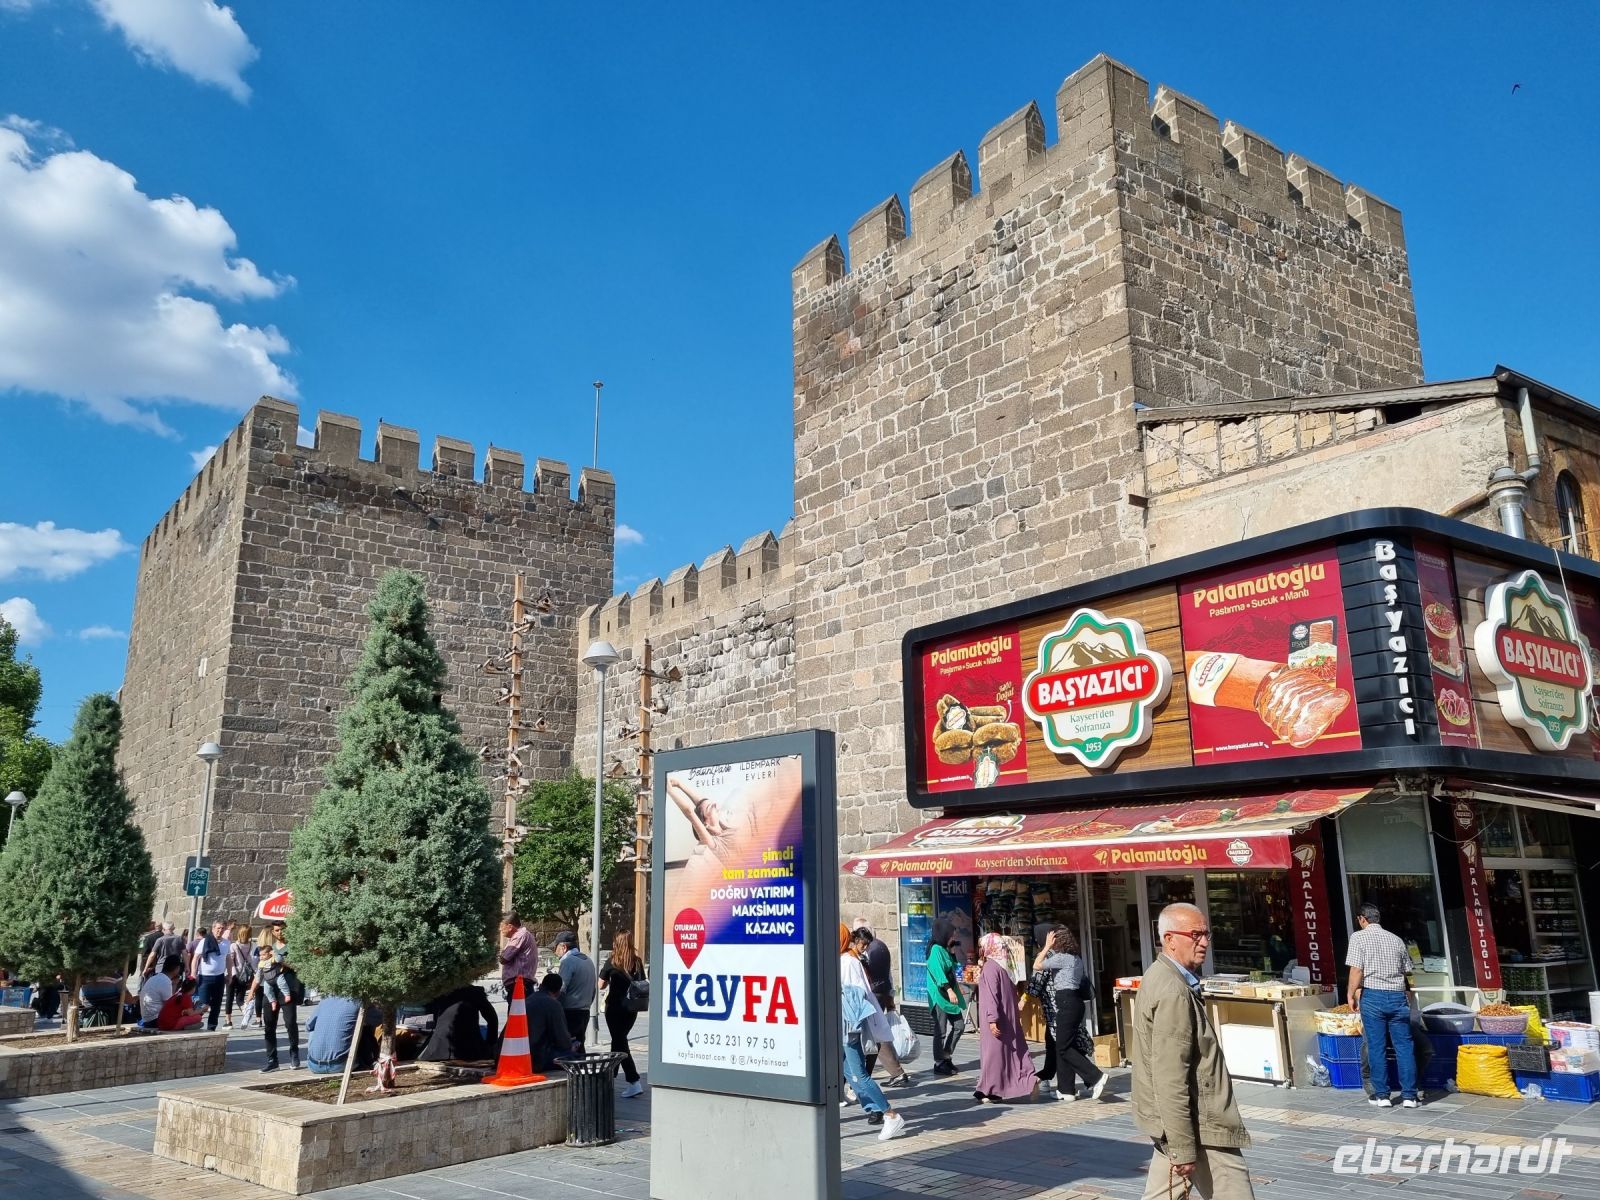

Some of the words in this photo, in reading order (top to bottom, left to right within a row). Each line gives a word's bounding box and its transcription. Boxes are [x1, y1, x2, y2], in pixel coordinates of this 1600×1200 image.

[1194, 563, 1326, 608] Palamutoğlu
[1209, 603, 1245, 618] Pastırma
[1251, 596, 1279, 609] Sucuk
[1285, 589, 1310, 602] Mantı
[931, 634, 1012, 667] Palamutoğlu
[1503, 636, 1579, 678] BAŞYAZICI
[1038, 665, 1143, 706] BAŞYAZICI
[1070, 709, 1114, 725] Kayseri'den
[1074, 720, 1111, 734] Sofranıza
[1085, 742, 1102, 753] 1953
[762, 846, 794, 864] şimdi
[1111, 844, 1208, 864] Palamutoğlu
[891, 857, 953, 873] Palamutoğlu
[975, 857, 1024, 870] Kayseri'den
[1025, 855, 1068, 867] Sofranıza
[722, 867, 745, 880] tam
[747, 863, 794, 879] zamanı!
[710, 885, 748, 900] DOĞRU
[750, 886, 795, 899] YATIRIM
[941, 880, 968, 894] Erikli
[732, 901, 795, 917] MAKSİMUM
[674, 923, 705, 932] OTURMAYA
[745, 922, 795, 936] KAZANÇ
[1301, 871, 1322, 982] PALAMUTOĞLU
[1469, 867, 1492, 980] PALAMUTOĞLU
[681, 942, 698, 950] EVLER
[694, 1033, 700, 1044] 0
[703, 1034, 721, 1045] 352
[726, 1035, 741, 1047] 231
[746, 1036, 758, 1048] 97
[763, 1038, 776, 1050] 50
